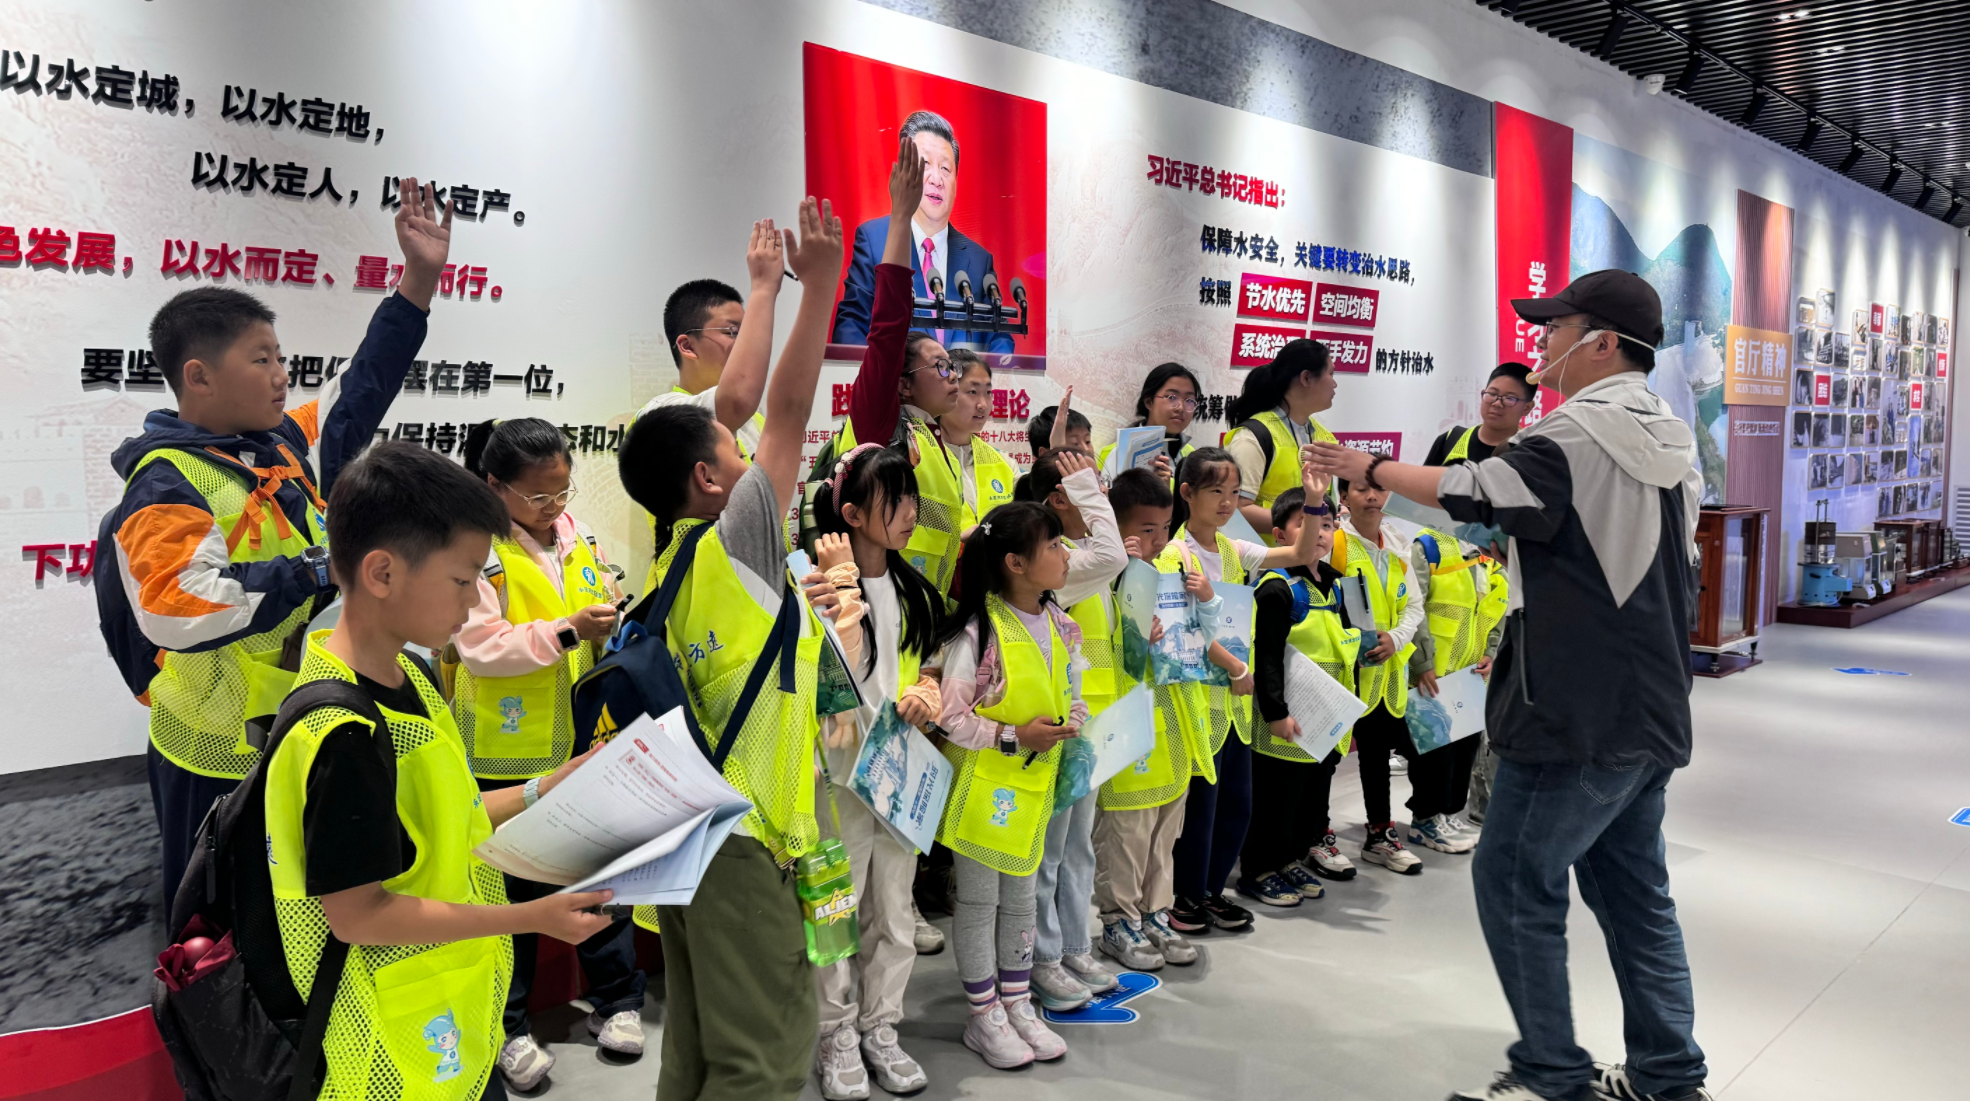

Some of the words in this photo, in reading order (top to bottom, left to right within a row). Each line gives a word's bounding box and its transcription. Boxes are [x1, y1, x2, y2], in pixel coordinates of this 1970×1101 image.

[1200, 277, 1232, 306] 按照
[1245, 282, 1306, 315] 节水优先
[1319, 292, 1374, 321] 空间均衡
[1376, 349, 1434, 374] 的方针治水
[1734, 337, 1787, 378] 官厅精神
[976, 431, 1030, 443] 的十八大将生
[1340, 440, 1394, 456] 资源节约
